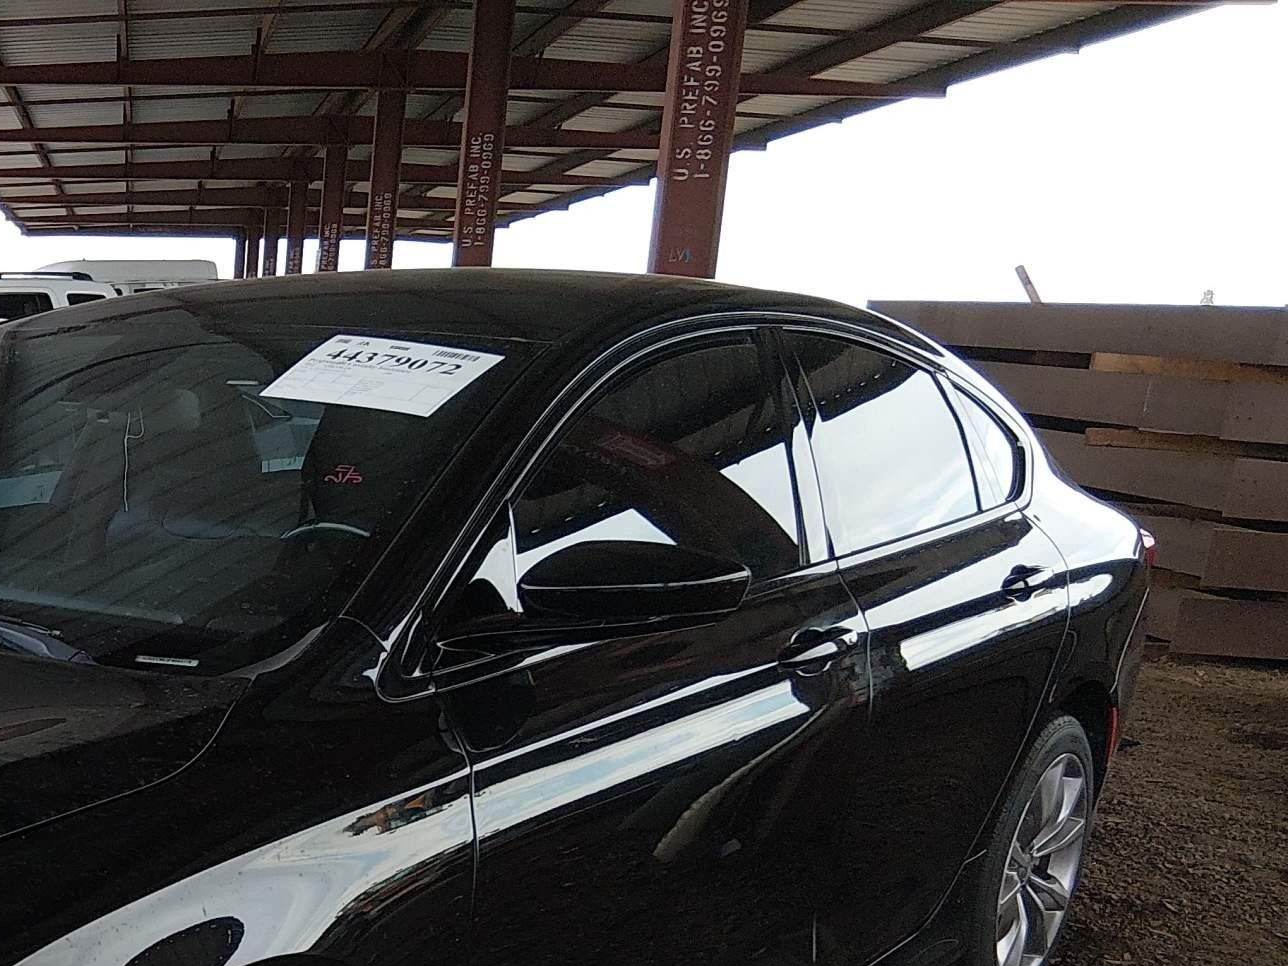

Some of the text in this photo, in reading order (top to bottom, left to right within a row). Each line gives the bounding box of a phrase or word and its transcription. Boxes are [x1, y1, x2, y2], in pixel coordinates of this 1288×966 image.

[678, 46, 704, 129] PREFAB
[464, 164, 479, 215] PREFAB
[326, 348, 463, 375] 44379072
